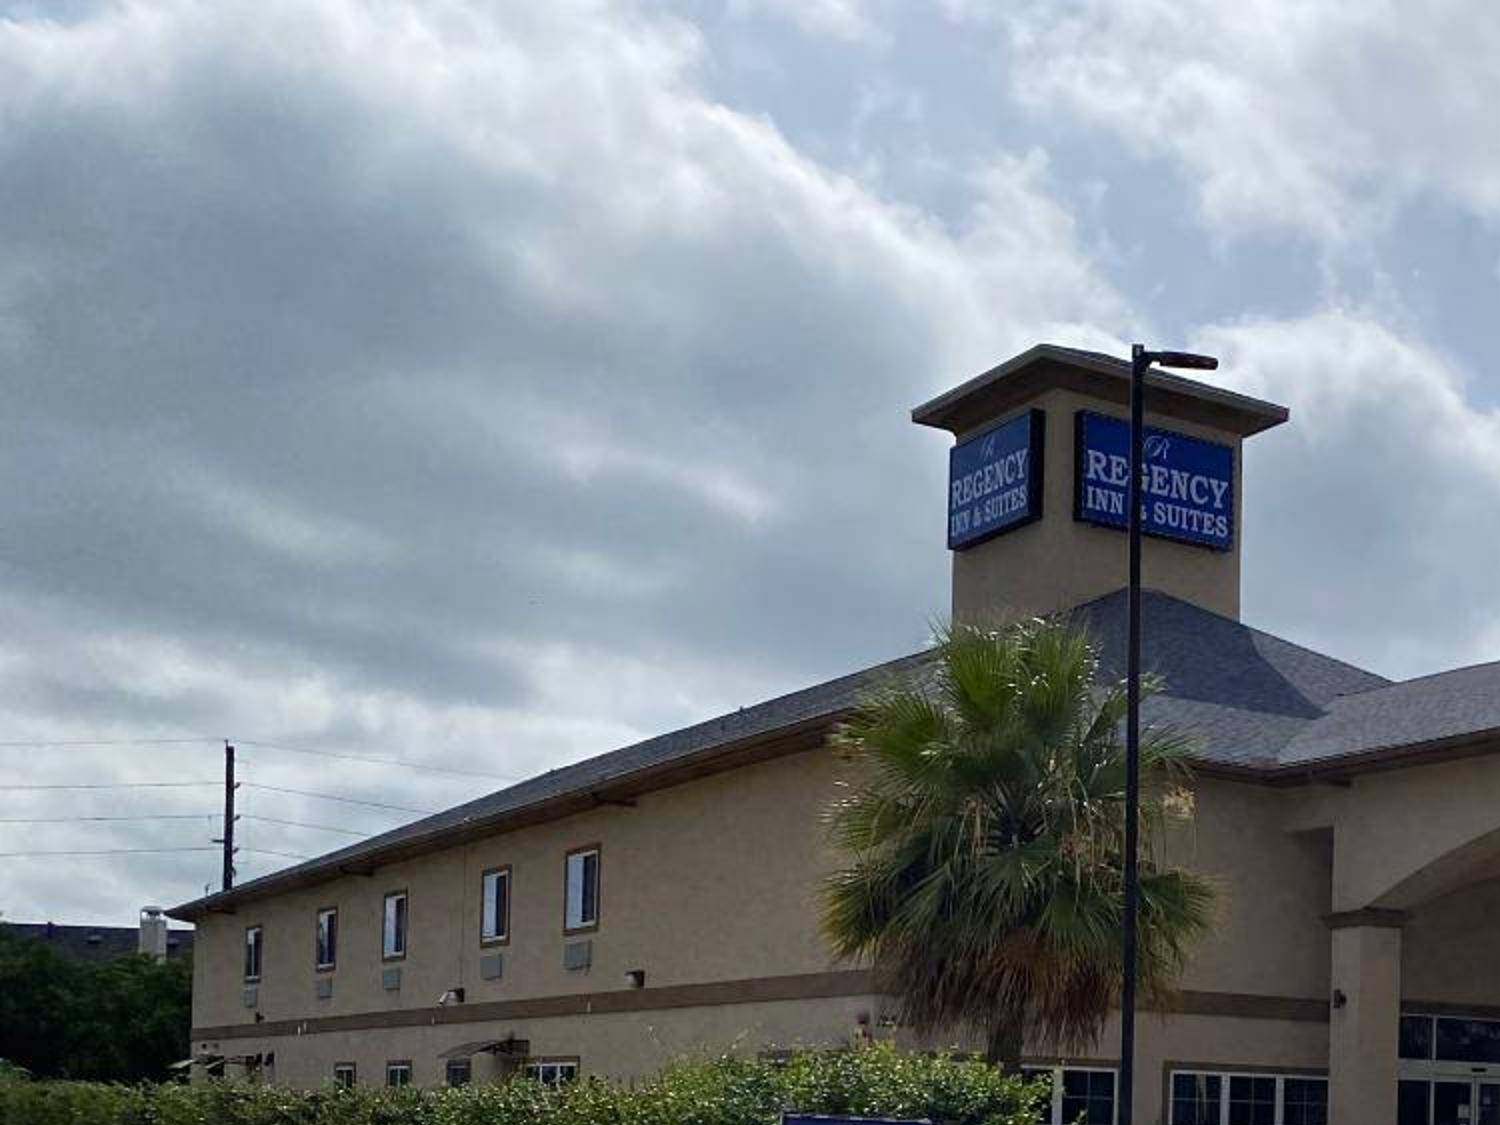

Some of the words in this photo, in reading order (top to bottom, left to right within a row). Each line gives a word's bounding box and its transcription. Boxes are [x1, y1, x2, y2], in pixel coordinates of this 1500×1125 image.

[951, 448, 1028, 513] REGENCY
[951, 509, 971, 537] INN
[984, 484, 1028, 523] SUITES
[1086, 486, 1125, 515] INN
[1153, 502, 1228, 538] SUITES
